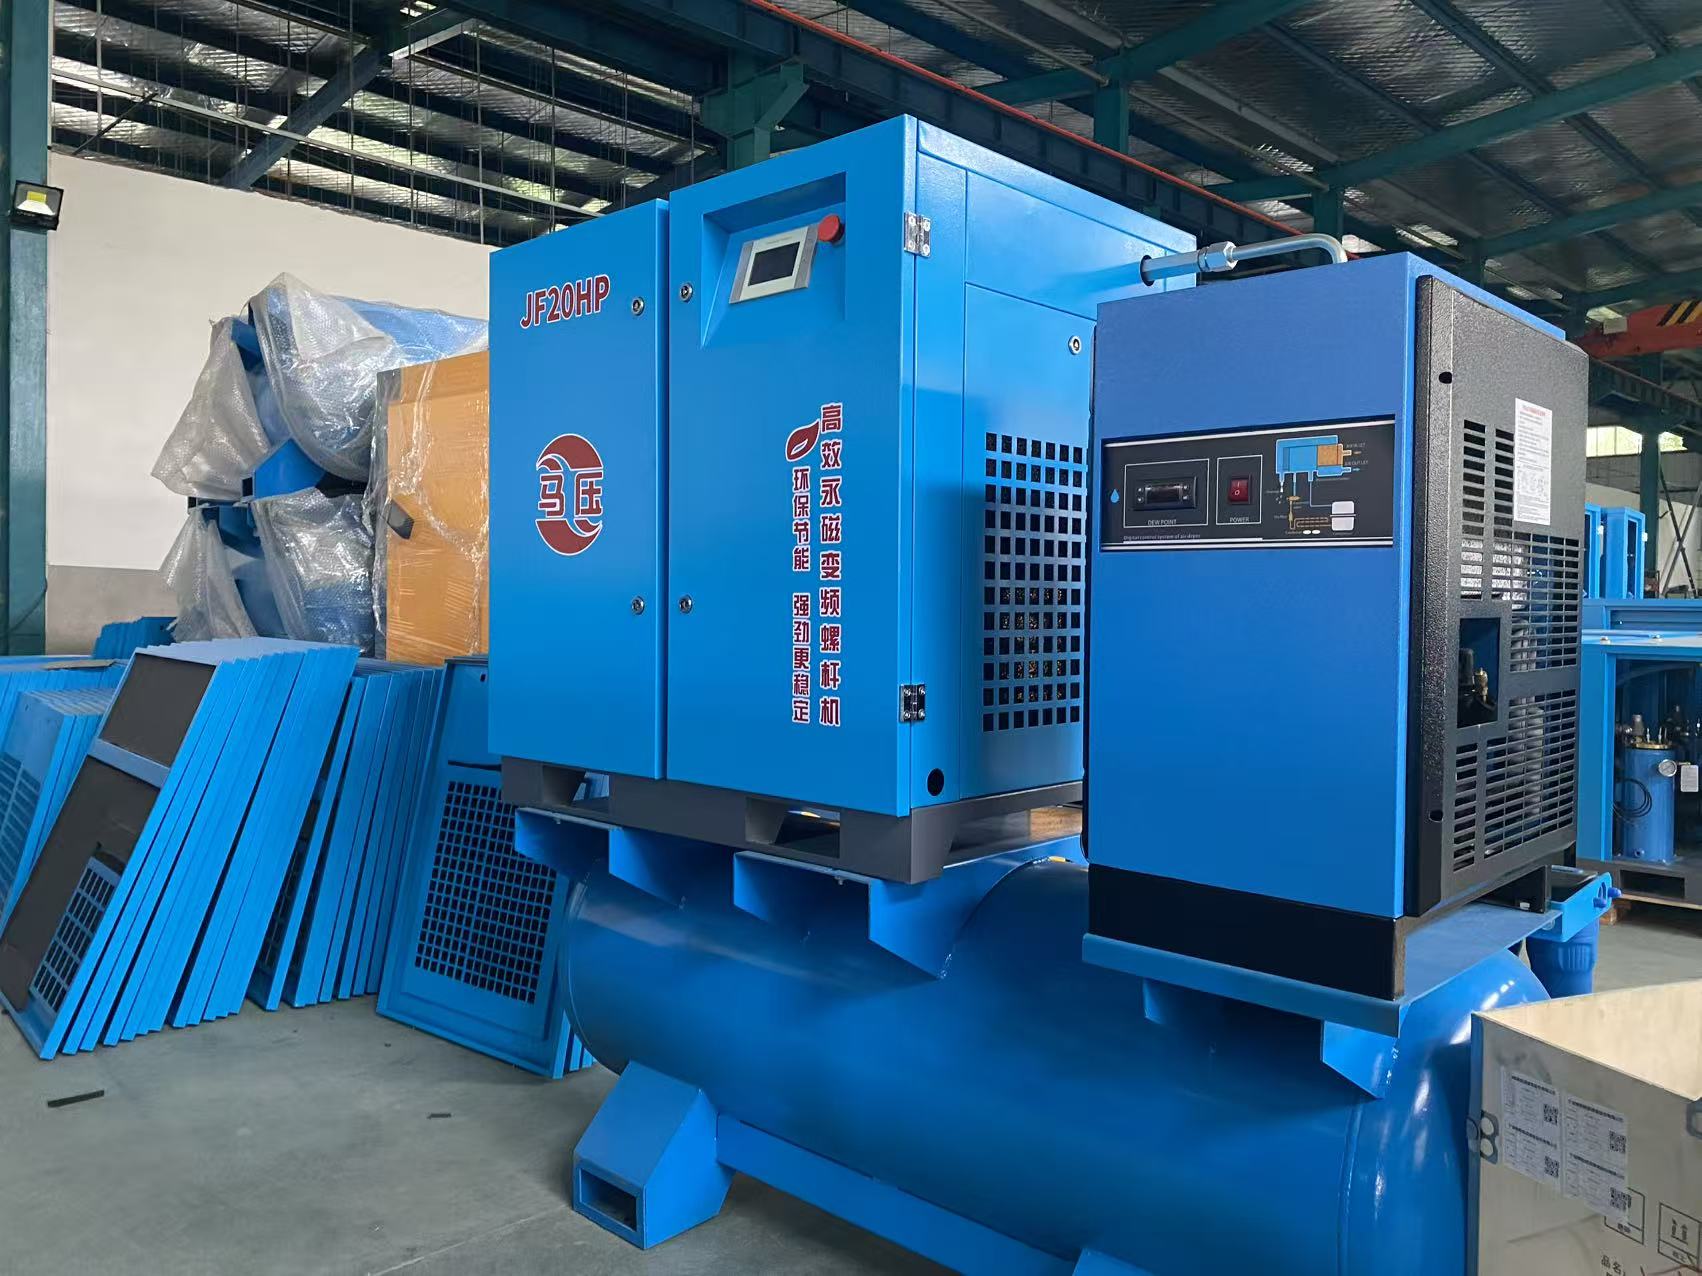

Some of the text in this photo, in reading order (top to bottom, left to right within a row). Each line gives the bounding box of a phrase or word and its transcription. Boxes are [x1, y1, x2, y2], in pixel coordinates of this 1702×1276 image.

[520, 274, 610, 329] JF20HP
[538, 470, 604, 518] 马压
[1160, 518, 1177, 526] POINT
[820, 402, 844, 727] 高效永磁变频螺杆机
[792, 466, 811, 725] 环保节能 强劲更稳定
